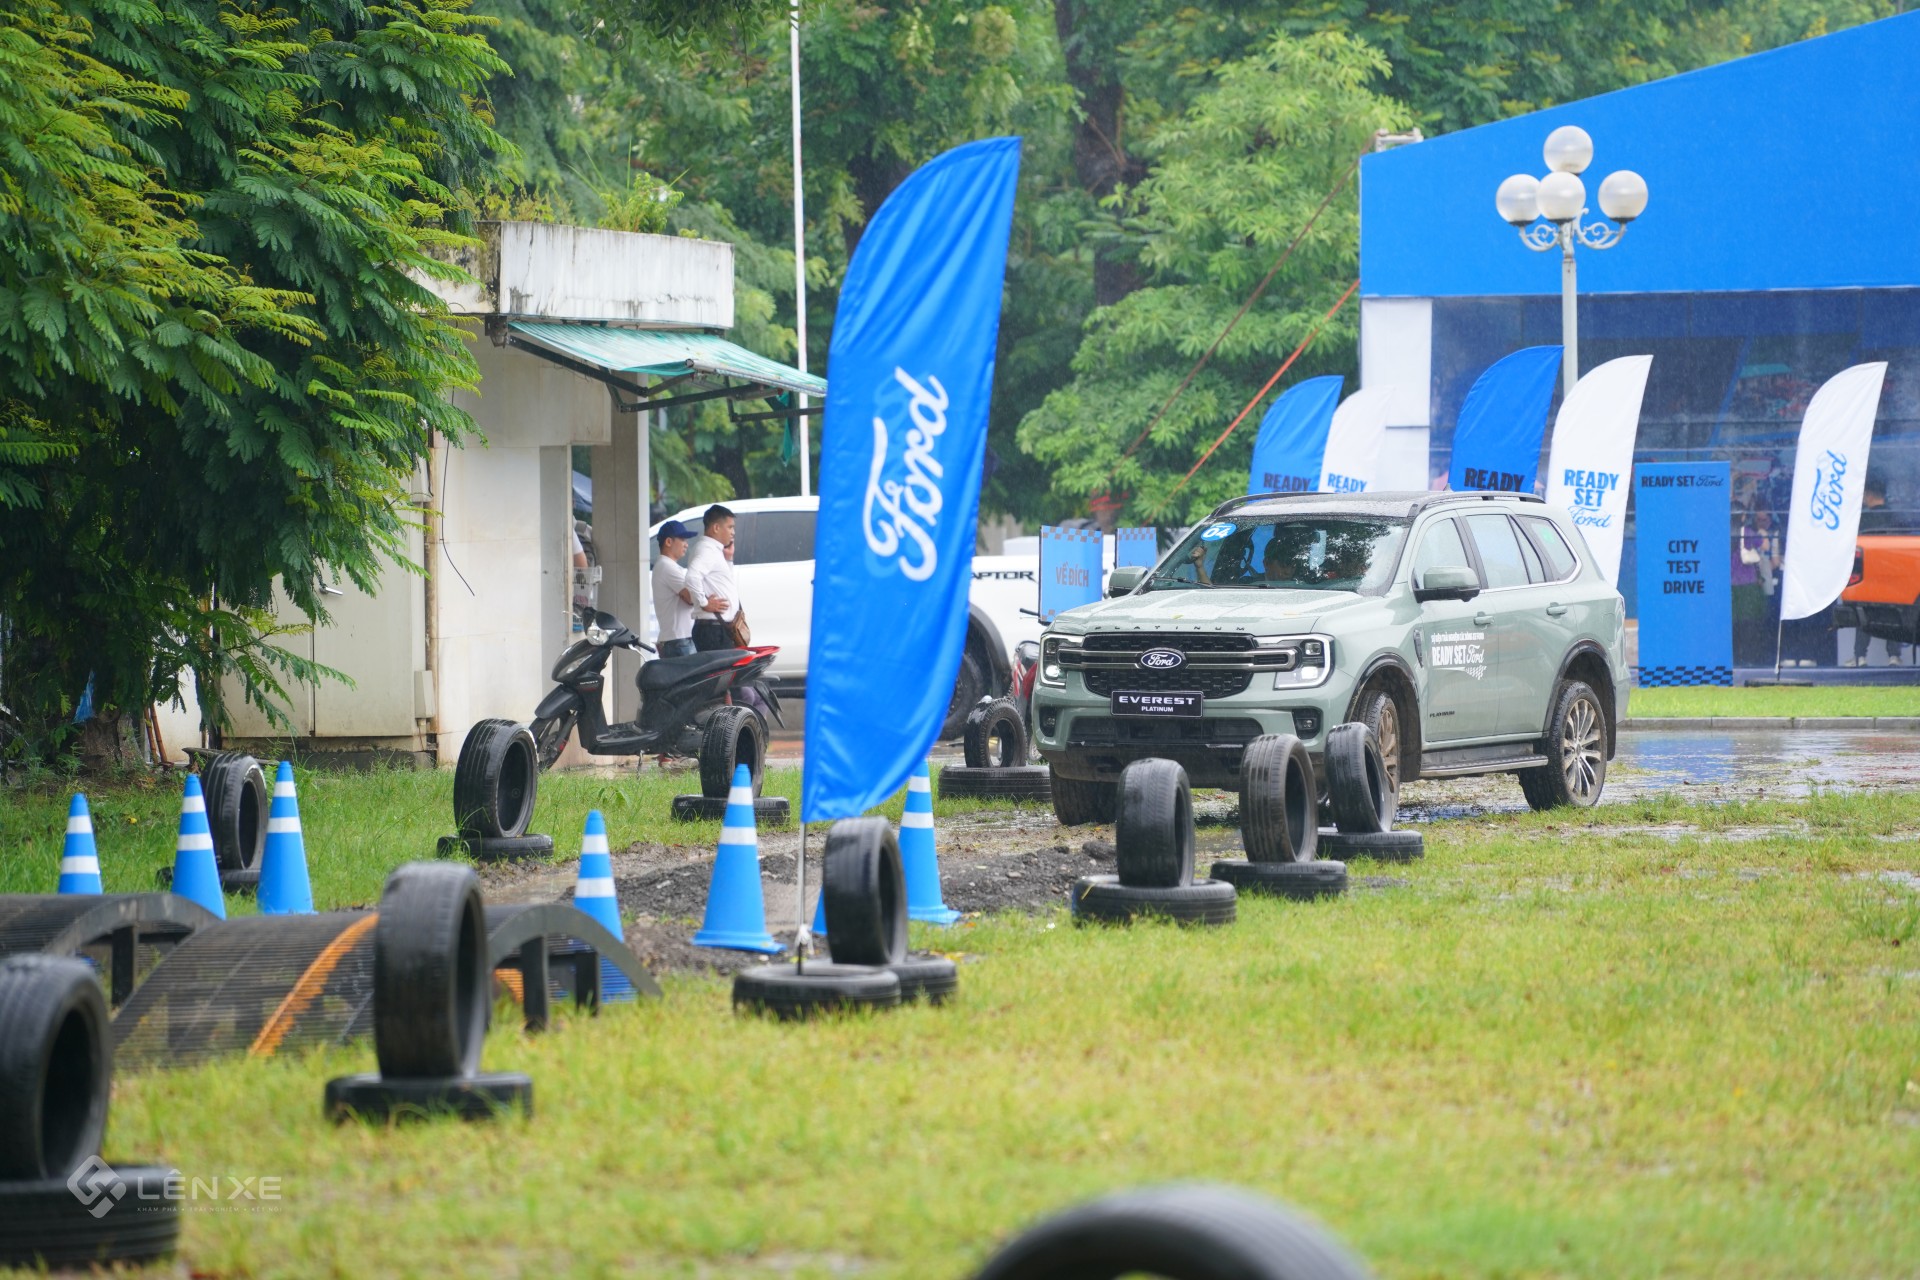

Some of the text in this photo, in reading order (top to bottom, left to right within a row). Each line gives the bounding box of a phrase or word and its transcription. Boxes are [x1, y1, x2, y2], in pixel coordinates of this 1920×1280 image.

[863, 366, 949, 582] Ford
[1263, 472, 1312, 491] READY
[1327, 472, 1367, 492] READY
[1463, 468, 1526, 492] READY
[1564, 469, 1619, 490] READY
[1641, 474, 1724, 488] READY SET Ford
[1574, 489, 1605, 507] SET
[1810, 449, 1847, 531] Ford
[1668, 540, 1698, 553] CITY
[1667, 560, 1700, 573] TEST
[970, 570, 1037, 584] APTOR
[1663, 580, 1705, 594] DRIVE
[1147, 653, 1174, 666] Ford
[1431, 644, 1485, 667] READY SET Ford
[1119, 695, 1195, 705] EVEREST
[1141, 705, 1174, 713] PLATINUM
